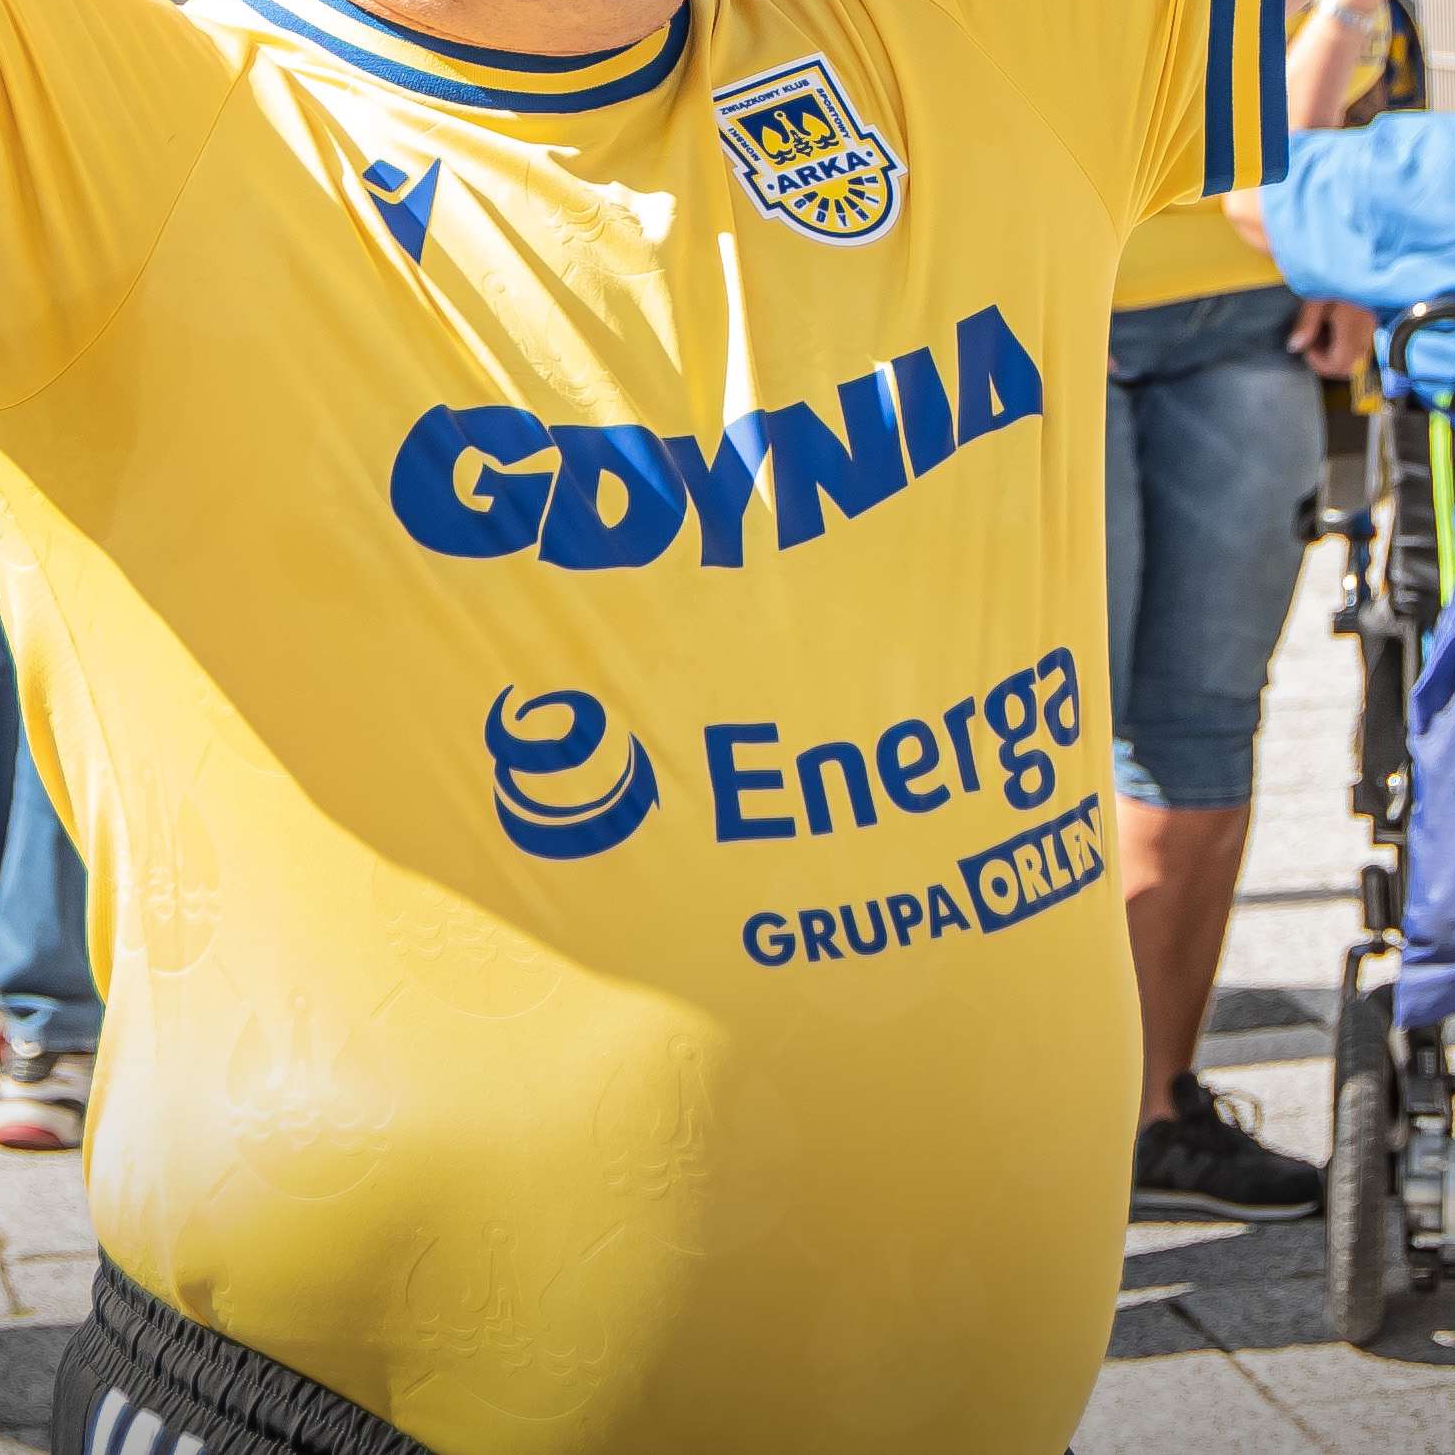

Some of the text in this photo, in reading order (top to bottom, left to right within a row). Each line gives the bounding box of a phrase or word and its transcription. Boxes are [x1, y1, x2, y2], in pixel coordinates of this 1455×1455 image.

[782, 78, 811, 93] KLUB
[777, 151, 871, 194] ARKA
[390, 304, 1044, 570] GDYNIA
[705, 646, 1080, 843] Energa
[743, 884, 971, 967] GRUPA
